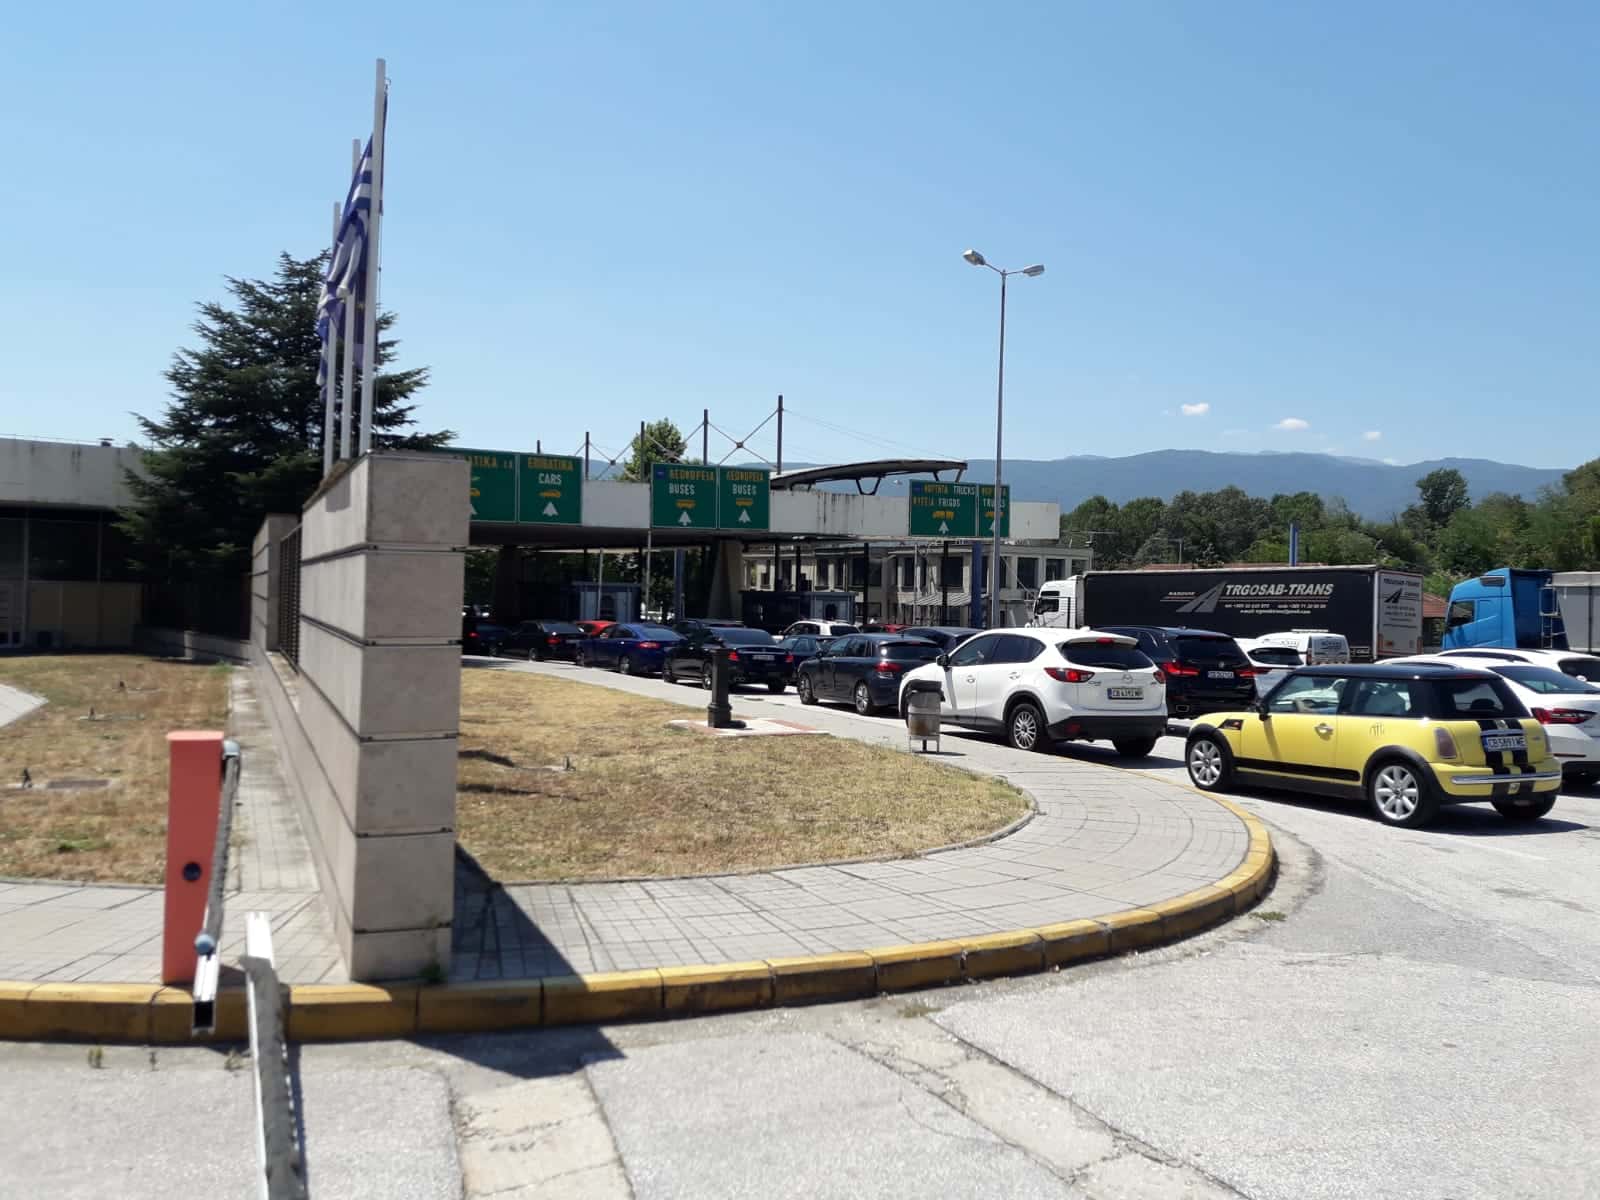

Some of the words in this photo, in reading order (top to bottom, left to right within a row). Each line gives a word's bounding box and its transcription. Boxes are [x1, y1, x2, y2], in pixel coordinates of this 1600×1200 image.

[538, 473, 562, 485] CARS
[669, 483, 695, 495] BUSES
[732, 484, 757, 495] BUSES
[1225, 584, 1335, 596] TRGOSAB-TRANS
